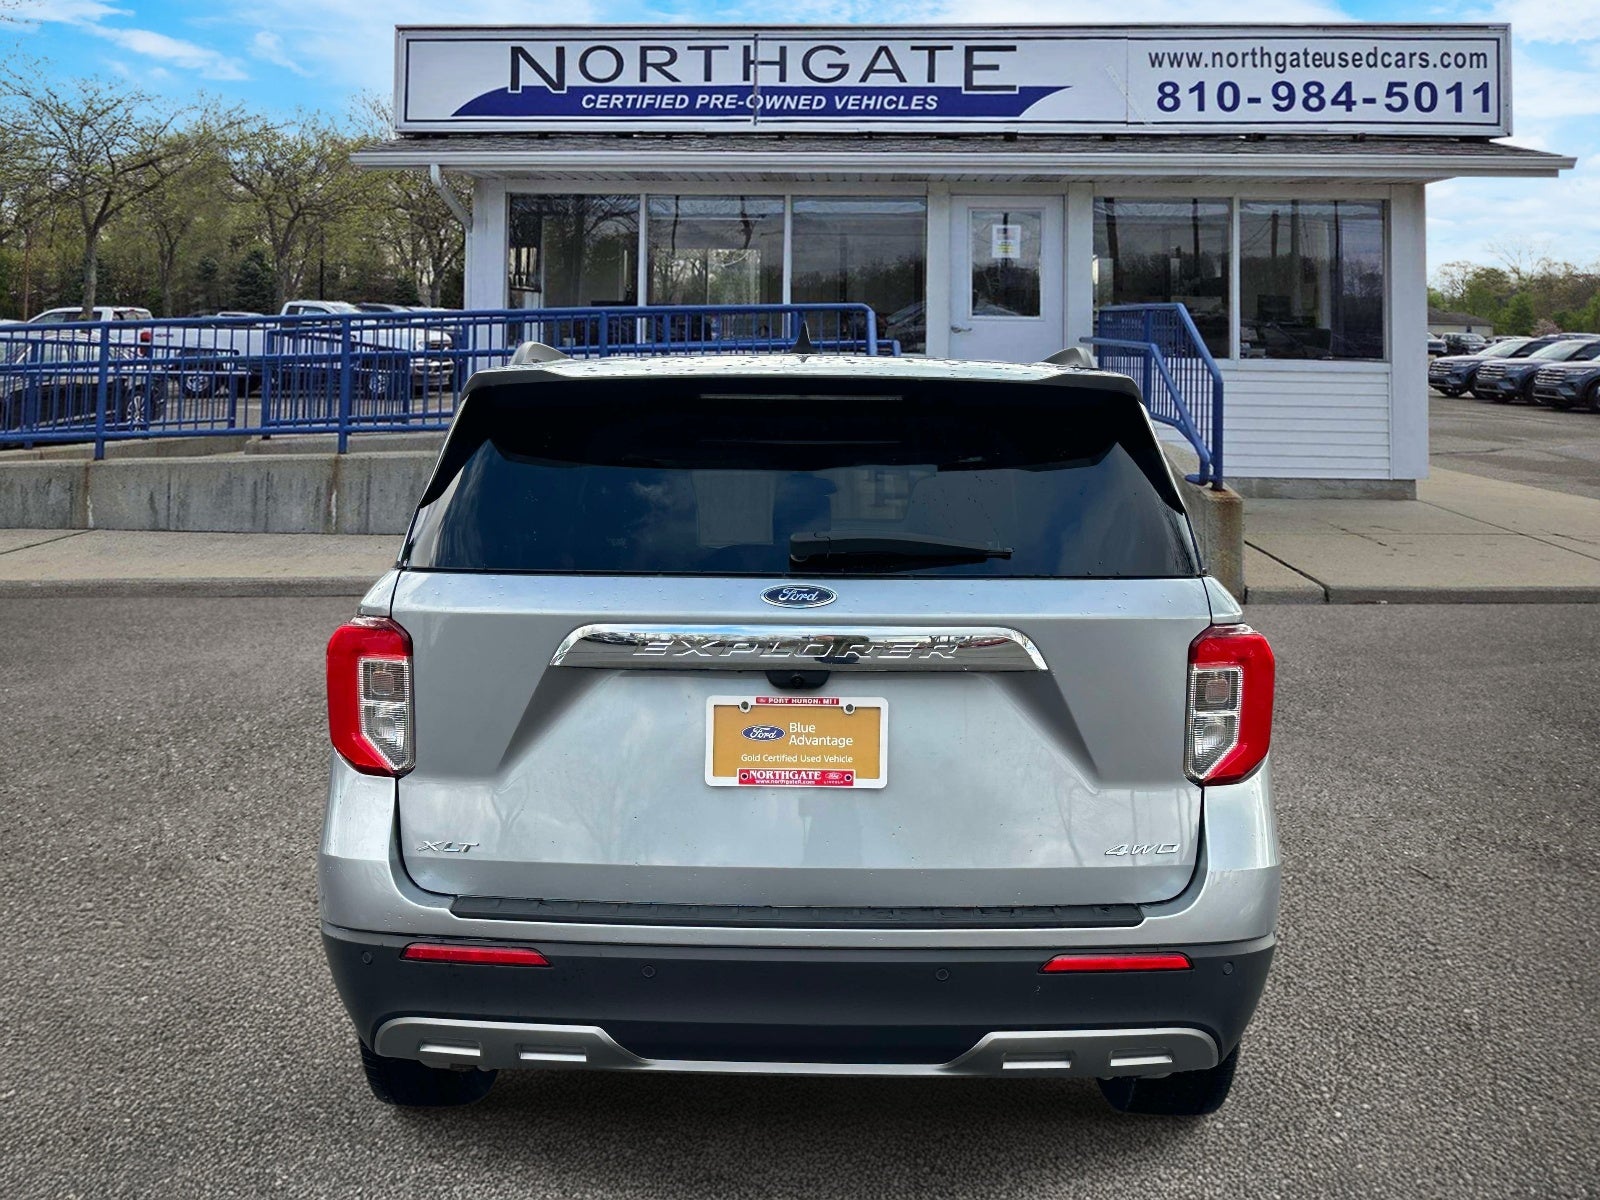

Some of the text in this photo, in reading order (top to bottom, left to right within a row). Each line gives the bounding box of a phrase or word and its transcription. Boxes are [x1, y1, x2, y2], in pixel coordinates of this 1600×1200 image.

[1148, 46, 1488, 73] www.northgateusedcars.com
[510, 45, 1017, 95] NORTHGATE
[581, 93, 938, 111] CERTIFIED PRE-OWNED VEHICLES
[1156, 80, 1491, 114] 810-984-5011
[632, 640, 958, 659] EXPLORER
[749, 726, 777, 739] Ford
[789, 722, 816, 734] Blue
[789, 734, 853, 747] Advantage
[741, 754, 853, 763] Gold Certified Used Vehicle
[749, 770, 822, 780] NORTHGATE
[416, 840, 480, 853] XLT
[1104, 843, 1180, 856] 4WD
